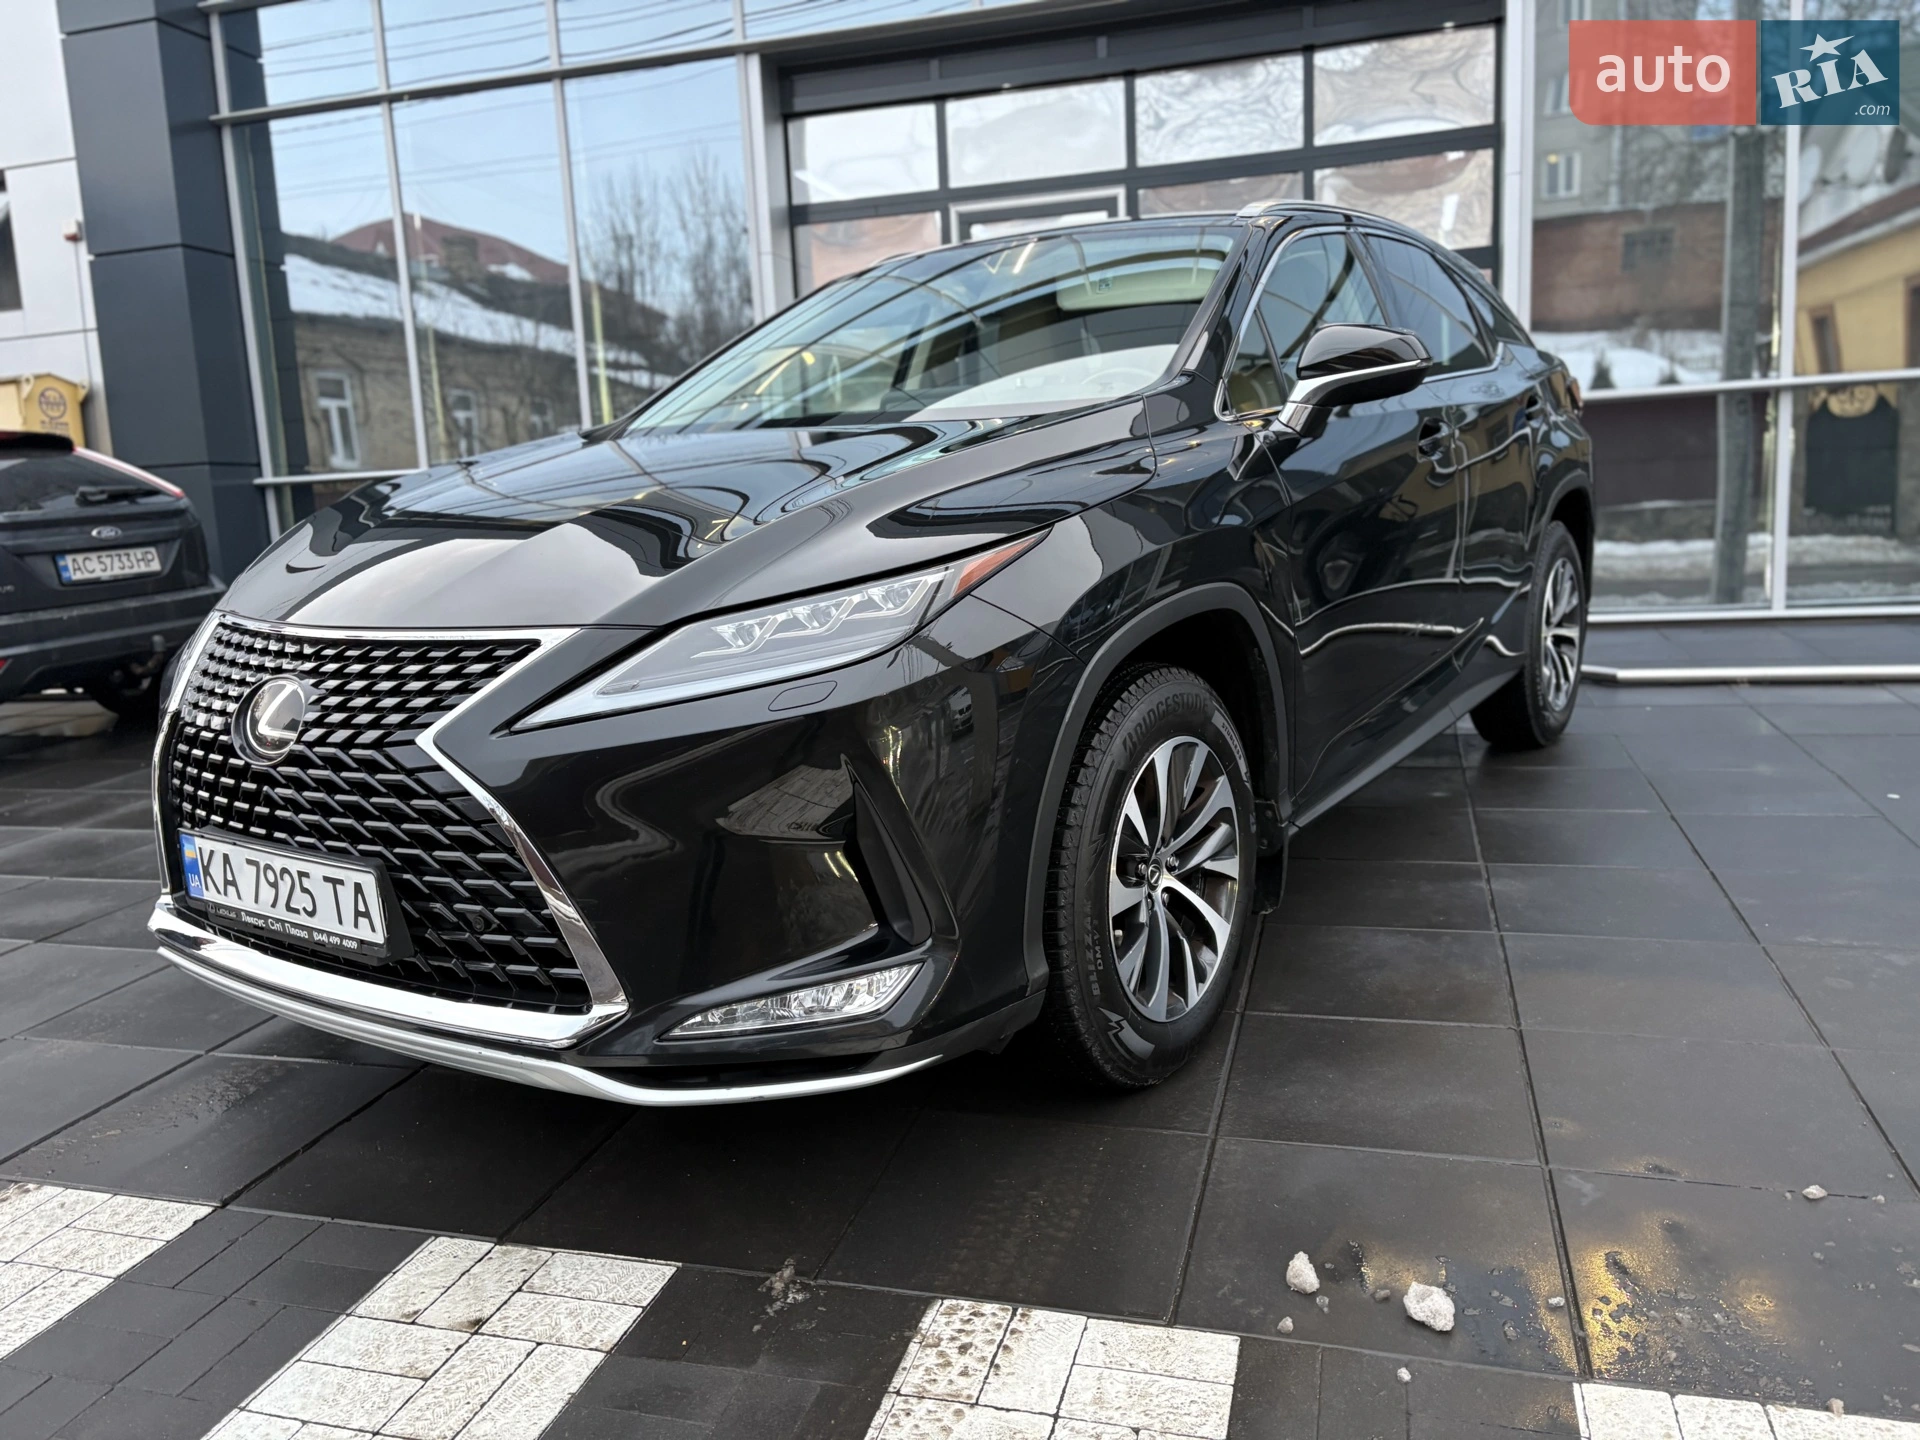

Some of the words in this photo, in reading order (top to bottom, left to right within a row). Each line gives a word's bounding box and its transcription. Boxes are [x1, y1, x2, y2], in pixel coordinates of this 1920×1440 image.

[72, 557, 96, 576] AC
[97, 552, 134, 573] 5733
[136, 549, 156, 569] HP
[1122, 692, 1210, 757] BRIDGESTONE
[1221, 721, 1243, 761] STUDLESS
[188, 872, 202, 890] UA
[198, 846, 242, 901] KA
[246, 857, 318, 918] 7925
[322, 875, 376, 933] TA
[241, 911, 266, 928] Лексус
[286, 923, 309, 939] Плаза
[313, 931, 329, 944] (044)
[329, 935, 341, 946] 499
[342, 938, 358, 950] 4009
[1083, 898, 1101, 996] BLIZZAK
